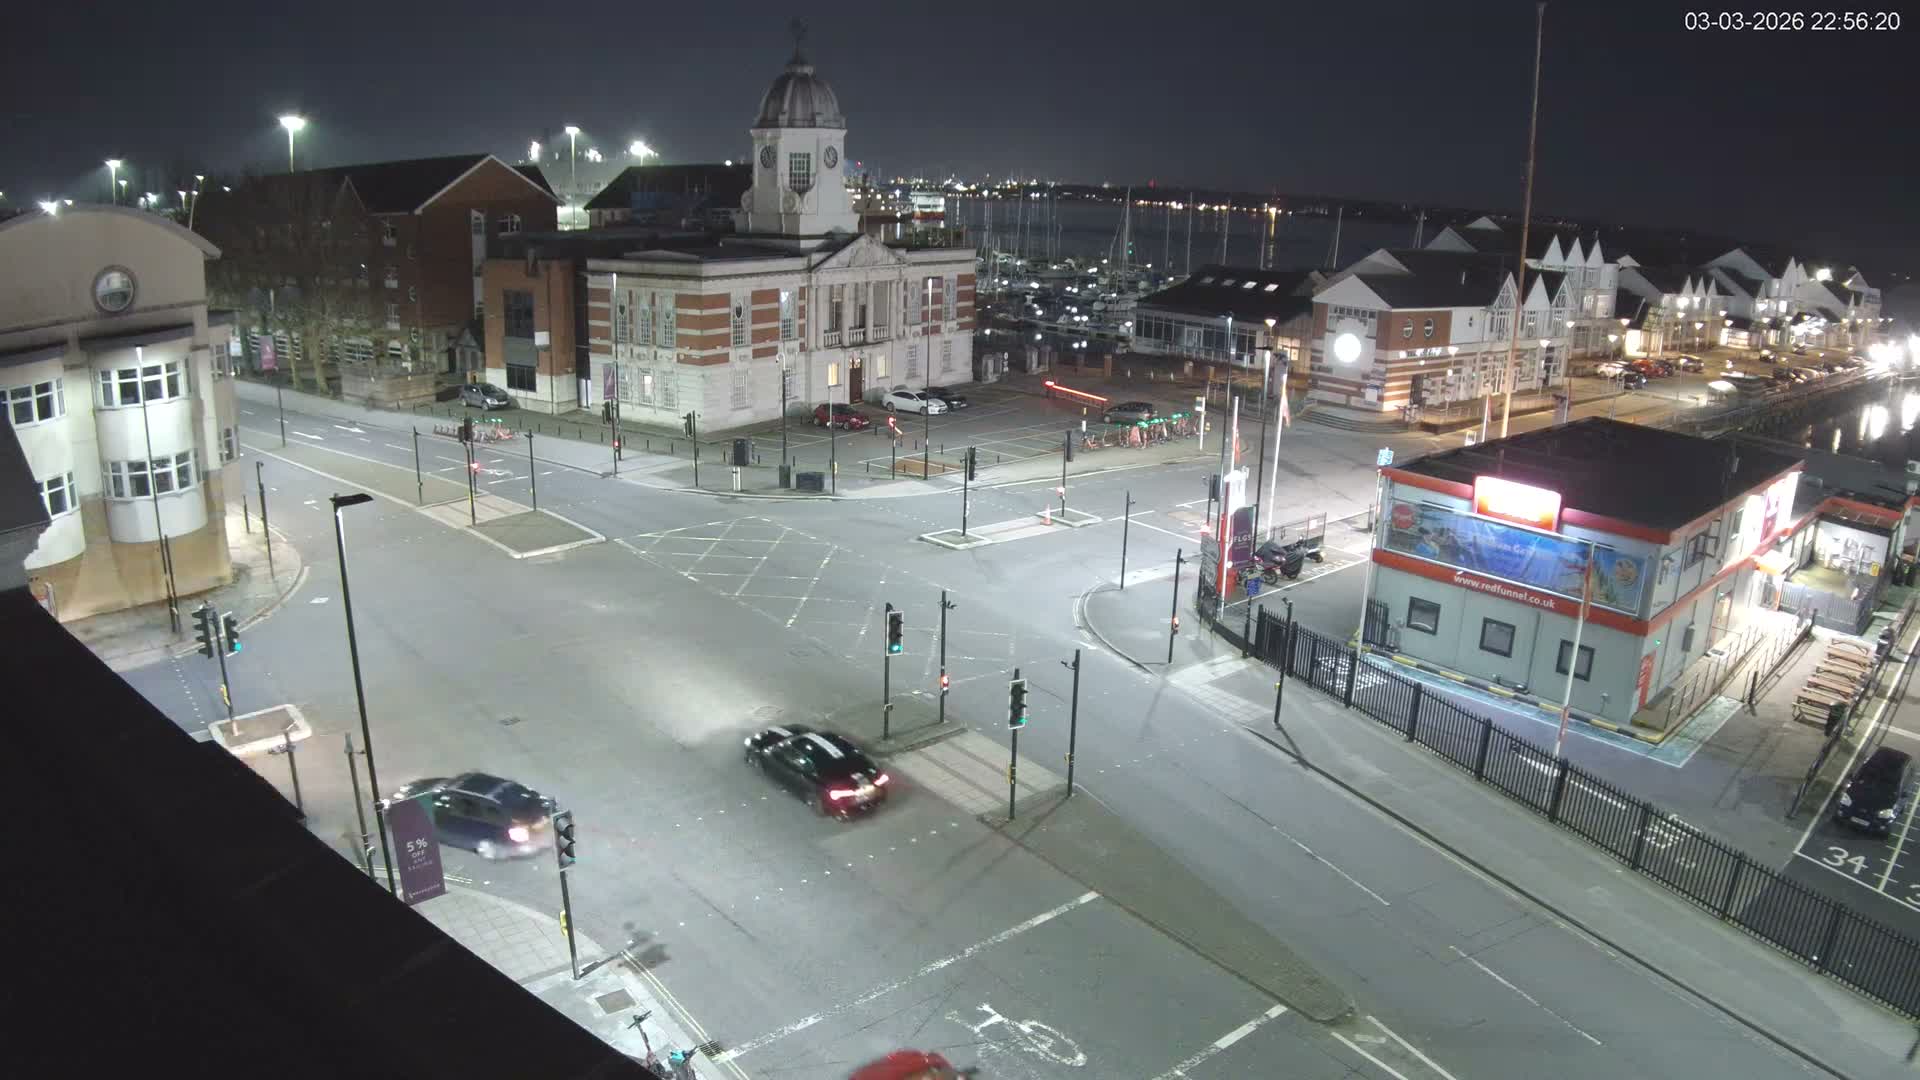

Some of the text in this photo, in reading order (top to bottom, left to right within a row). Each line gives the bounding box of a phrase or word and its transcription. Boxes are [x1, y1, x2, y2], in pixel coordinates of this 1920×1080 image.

[1453, 574, 1556, 609] www.redfunnel.co.uk
[406, 837, 428, 853] 5%
[411, 850, 425, 859] OFF
[1823, 846, 1869, 875] 34
